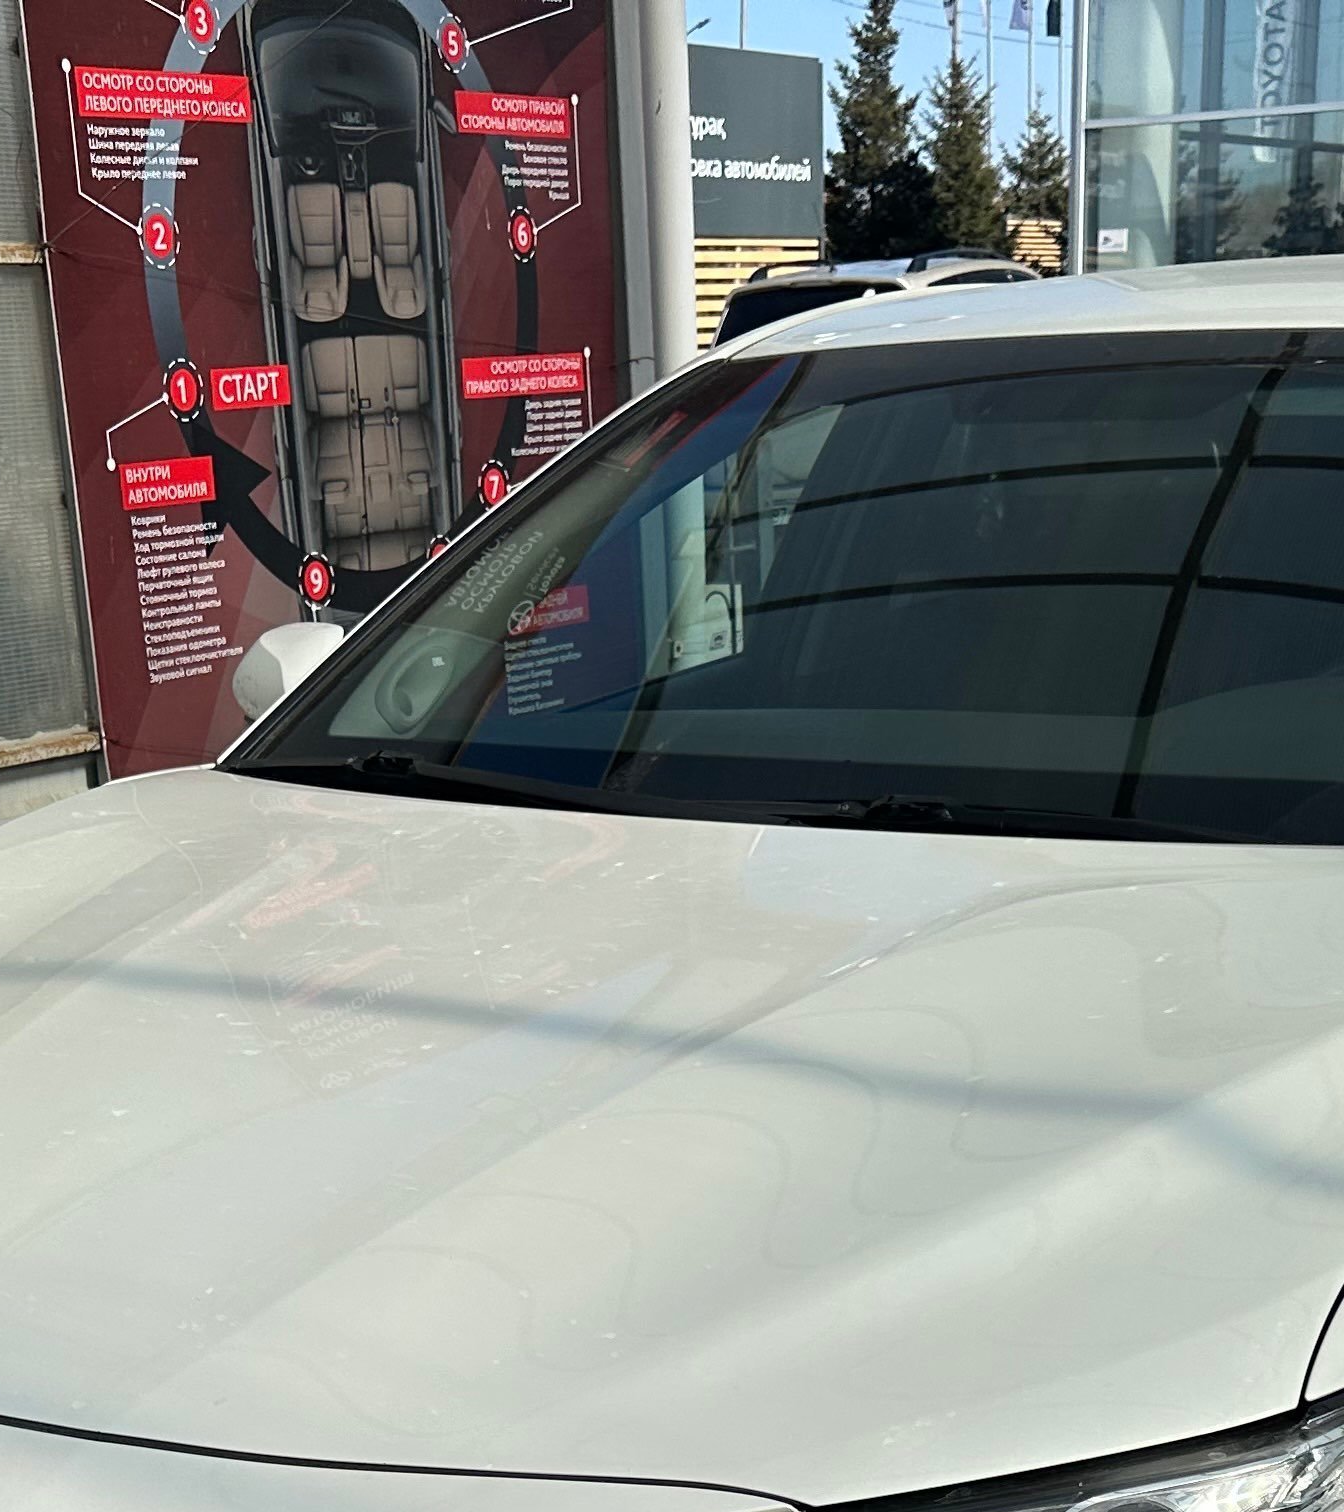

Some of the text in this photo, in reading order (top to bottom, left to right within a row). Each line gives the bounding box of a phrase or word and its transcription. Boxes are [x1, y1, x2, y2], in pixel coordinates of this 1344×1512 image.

[194, 6, 208, 36] 3
[447, 30, 459, 56] 5
[82, 72, 213, 94] ОСМОТР СО СТОРОНЫ
[84, 95, 247, 118] ЛЕВОГО ПЕРЕДНЕГО КОЛЕСА
[491, 97, 565, 115] ОСМОТР ПРАВОЙ
[86, 123, 130, 138] Наружное
[460, 114, 565, 134] СТОРОНЫ АВТОМОБИЛЯ
[723, 155, 812, 182] автомобилей
[152, 221, 167, 250] 2
[517, 222, 528, 246] 6
[490, 360, 527, 375] ОСМОТР
[528, 359, 541, 372] СО
[176, 376, 187, 404] 1
[218, 371, 281, 404] СТАРТ
[466, 375, 578, 395] ПРАВОГО ЗАДНЕГО КОЛЕСА
[125, 465, 171, 484] ВНУТРИ
[128, 481, 208, 505] АВТОМОБИЛЯ
[489, 475, 500, 499] 7
[130, 514, 166, 527] Коврики
[162, 521, 217, 536] безопасности
[133, 541, 150, 553] Ход
[150, 535, 195, 552] тормозной
[135, 552, 177, 566] Состояние
[309, 568, 323, 594] 9
